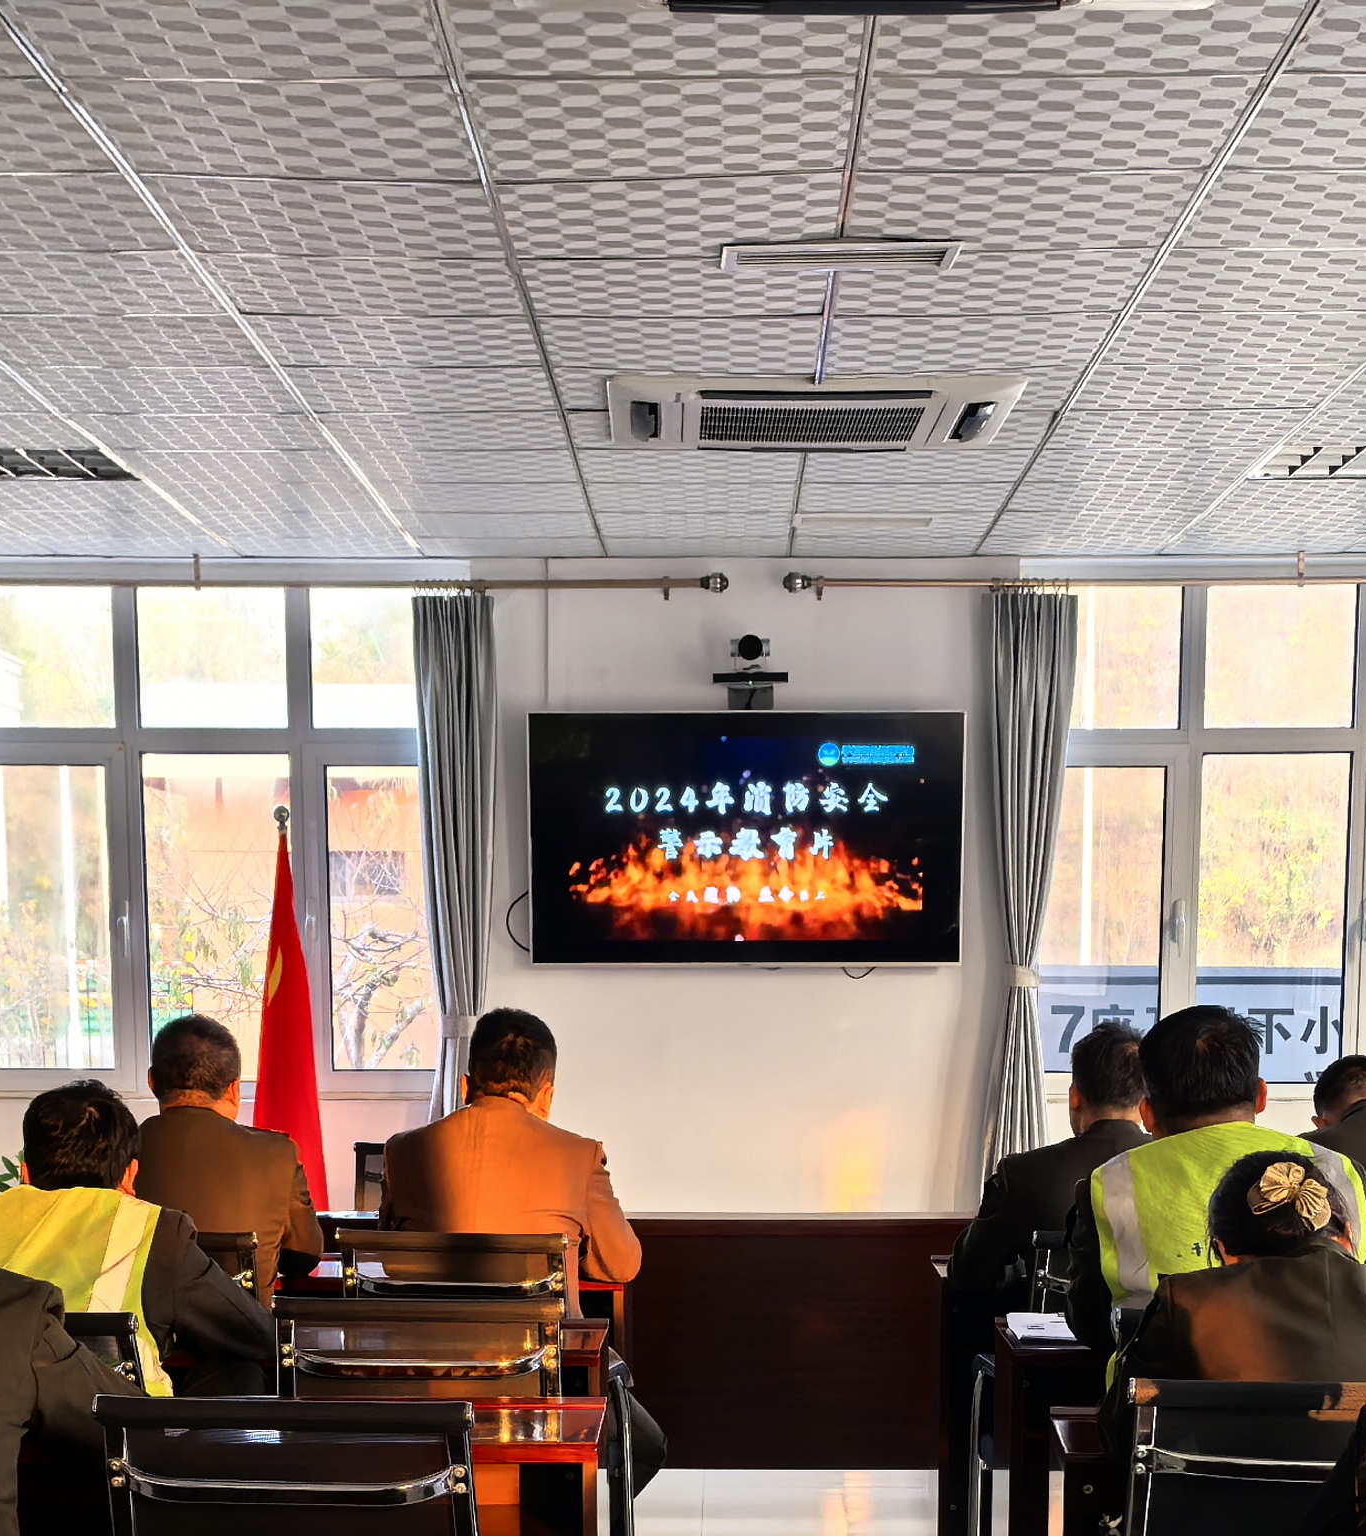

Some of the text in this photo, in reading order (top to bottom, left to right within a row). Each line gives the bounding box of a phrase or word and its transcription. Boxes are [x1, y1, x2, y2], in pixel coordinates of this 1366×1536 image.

[604, 781, 889, 816] 2024年消防安全
[657, 826, 835, 861] 警示教育片
